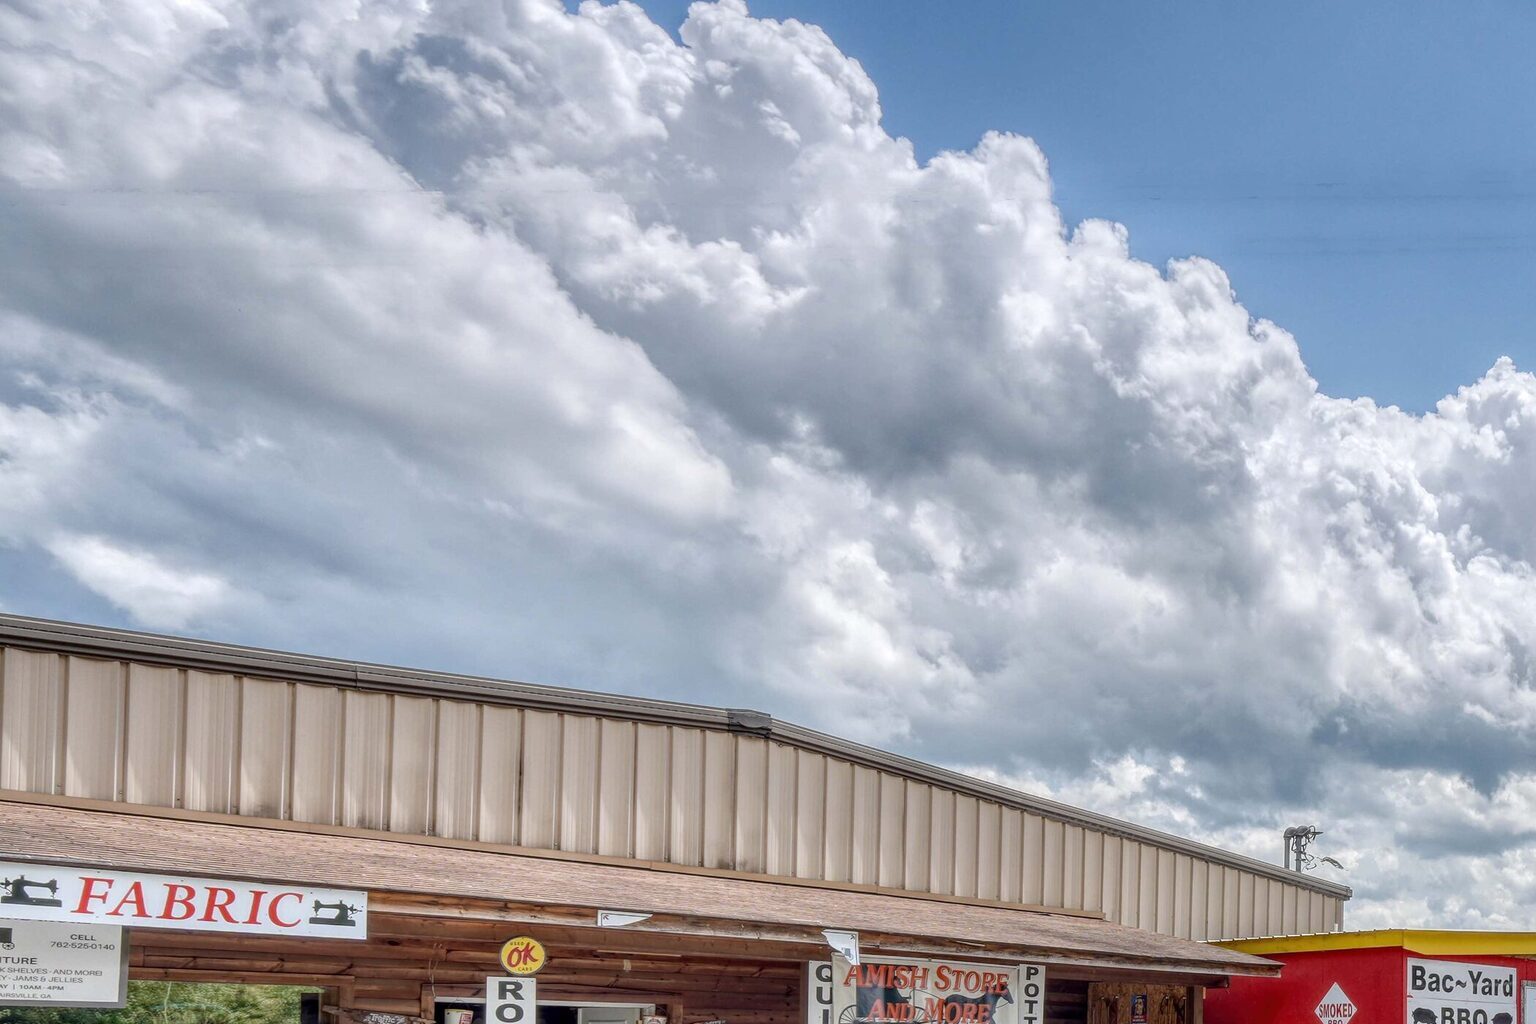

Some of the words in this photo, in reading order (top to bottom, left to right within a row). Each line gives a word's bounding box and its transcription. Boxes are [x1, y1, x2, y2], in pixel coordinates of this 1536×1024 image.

[71, 876, 304, 928] FABRIC
[51, 941, 115, 951] 762-525-0140
[507, 942, 539, 968] OK
[843, 964, 929, 990] AMISH
[934, 965, 1009, 994] STORE
[867, 998, 916, 1023] AND
[923, 997, 993, 1024] MORE
[1318, 1003, 1353, 1018] SMOKED
